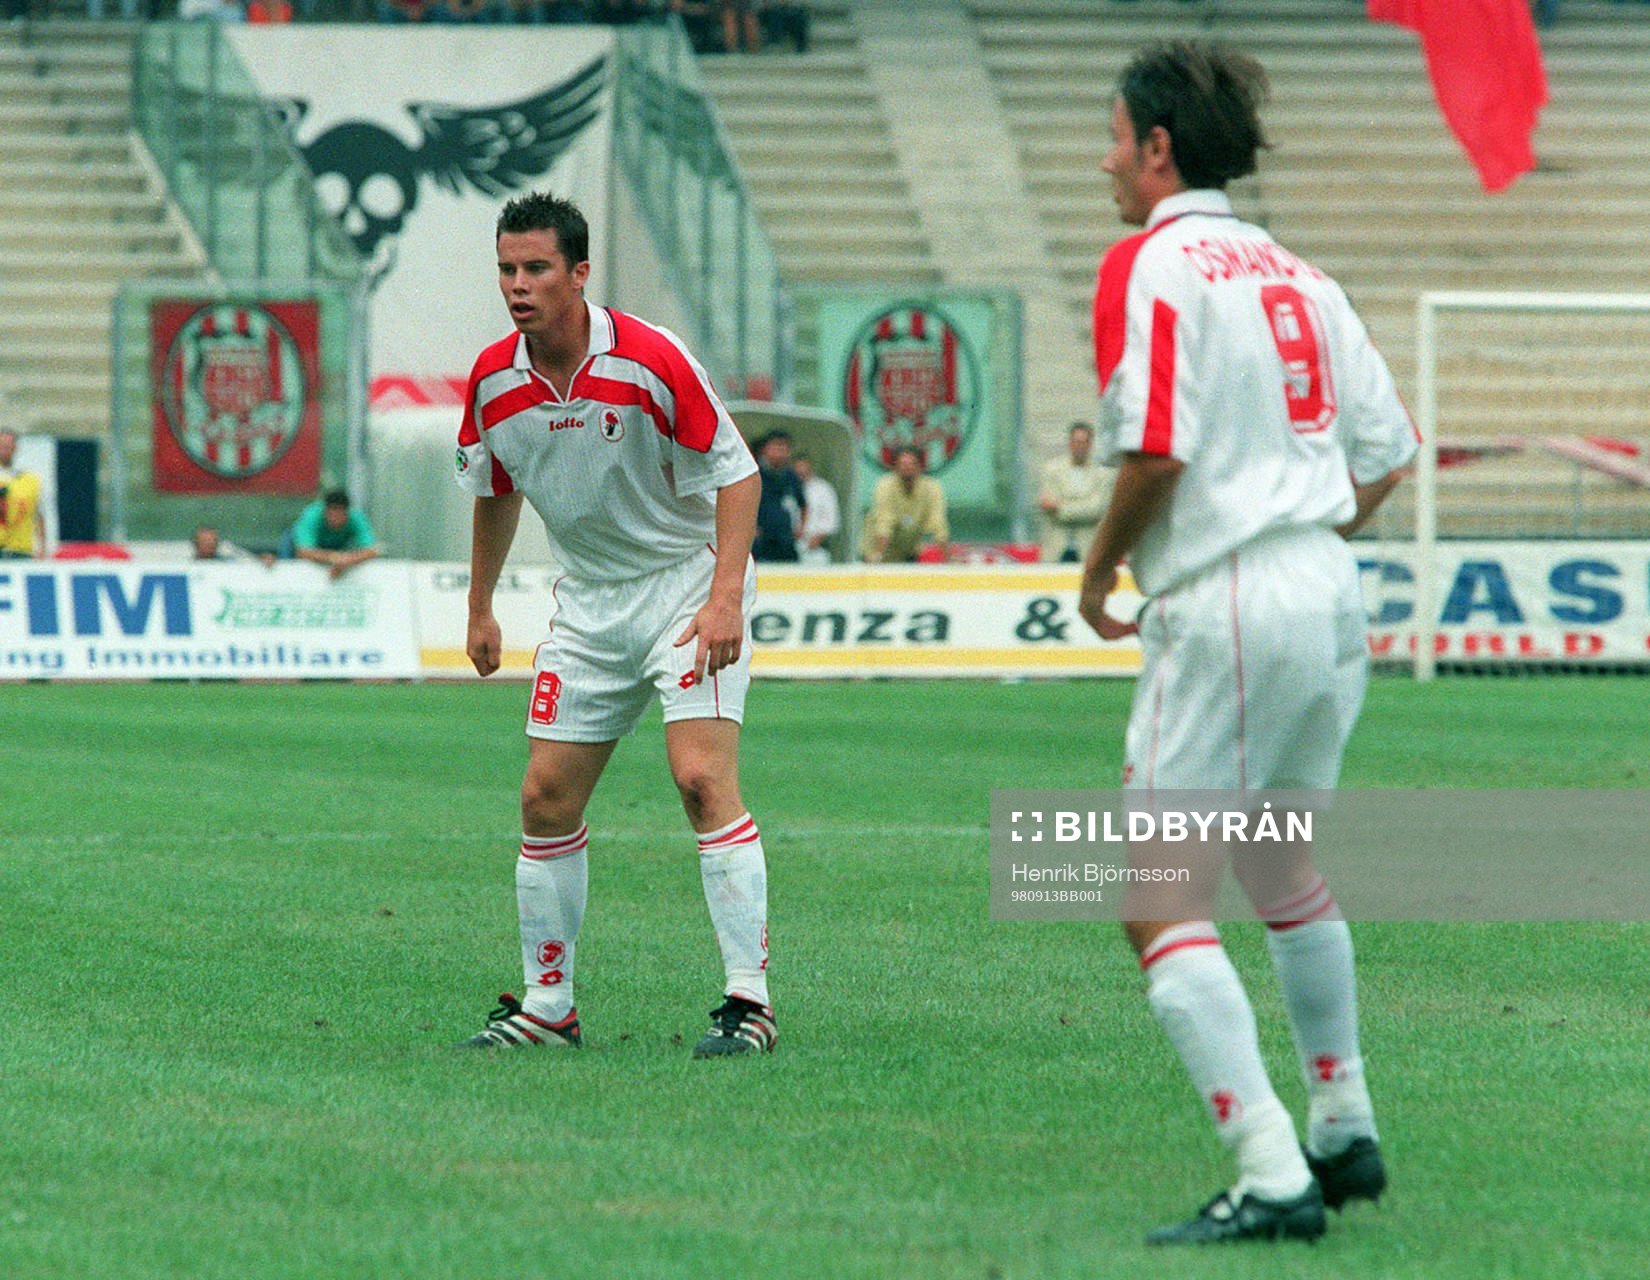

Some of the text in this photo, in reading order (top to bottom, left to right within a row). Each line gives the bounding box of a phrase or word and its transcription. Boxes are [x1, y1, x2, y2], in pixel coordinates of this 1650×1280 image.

[1261, 284, 1338, 434] 9
[549, 416, 585, 433] lotto
[0, 574, 193, 636] IM
[1015, 597, 1069, 642] &
[1357, 560, 1650, 625] CAS
[87, 645, 384, 666] Immobiliare
[531, 670, 562, 726] 8
